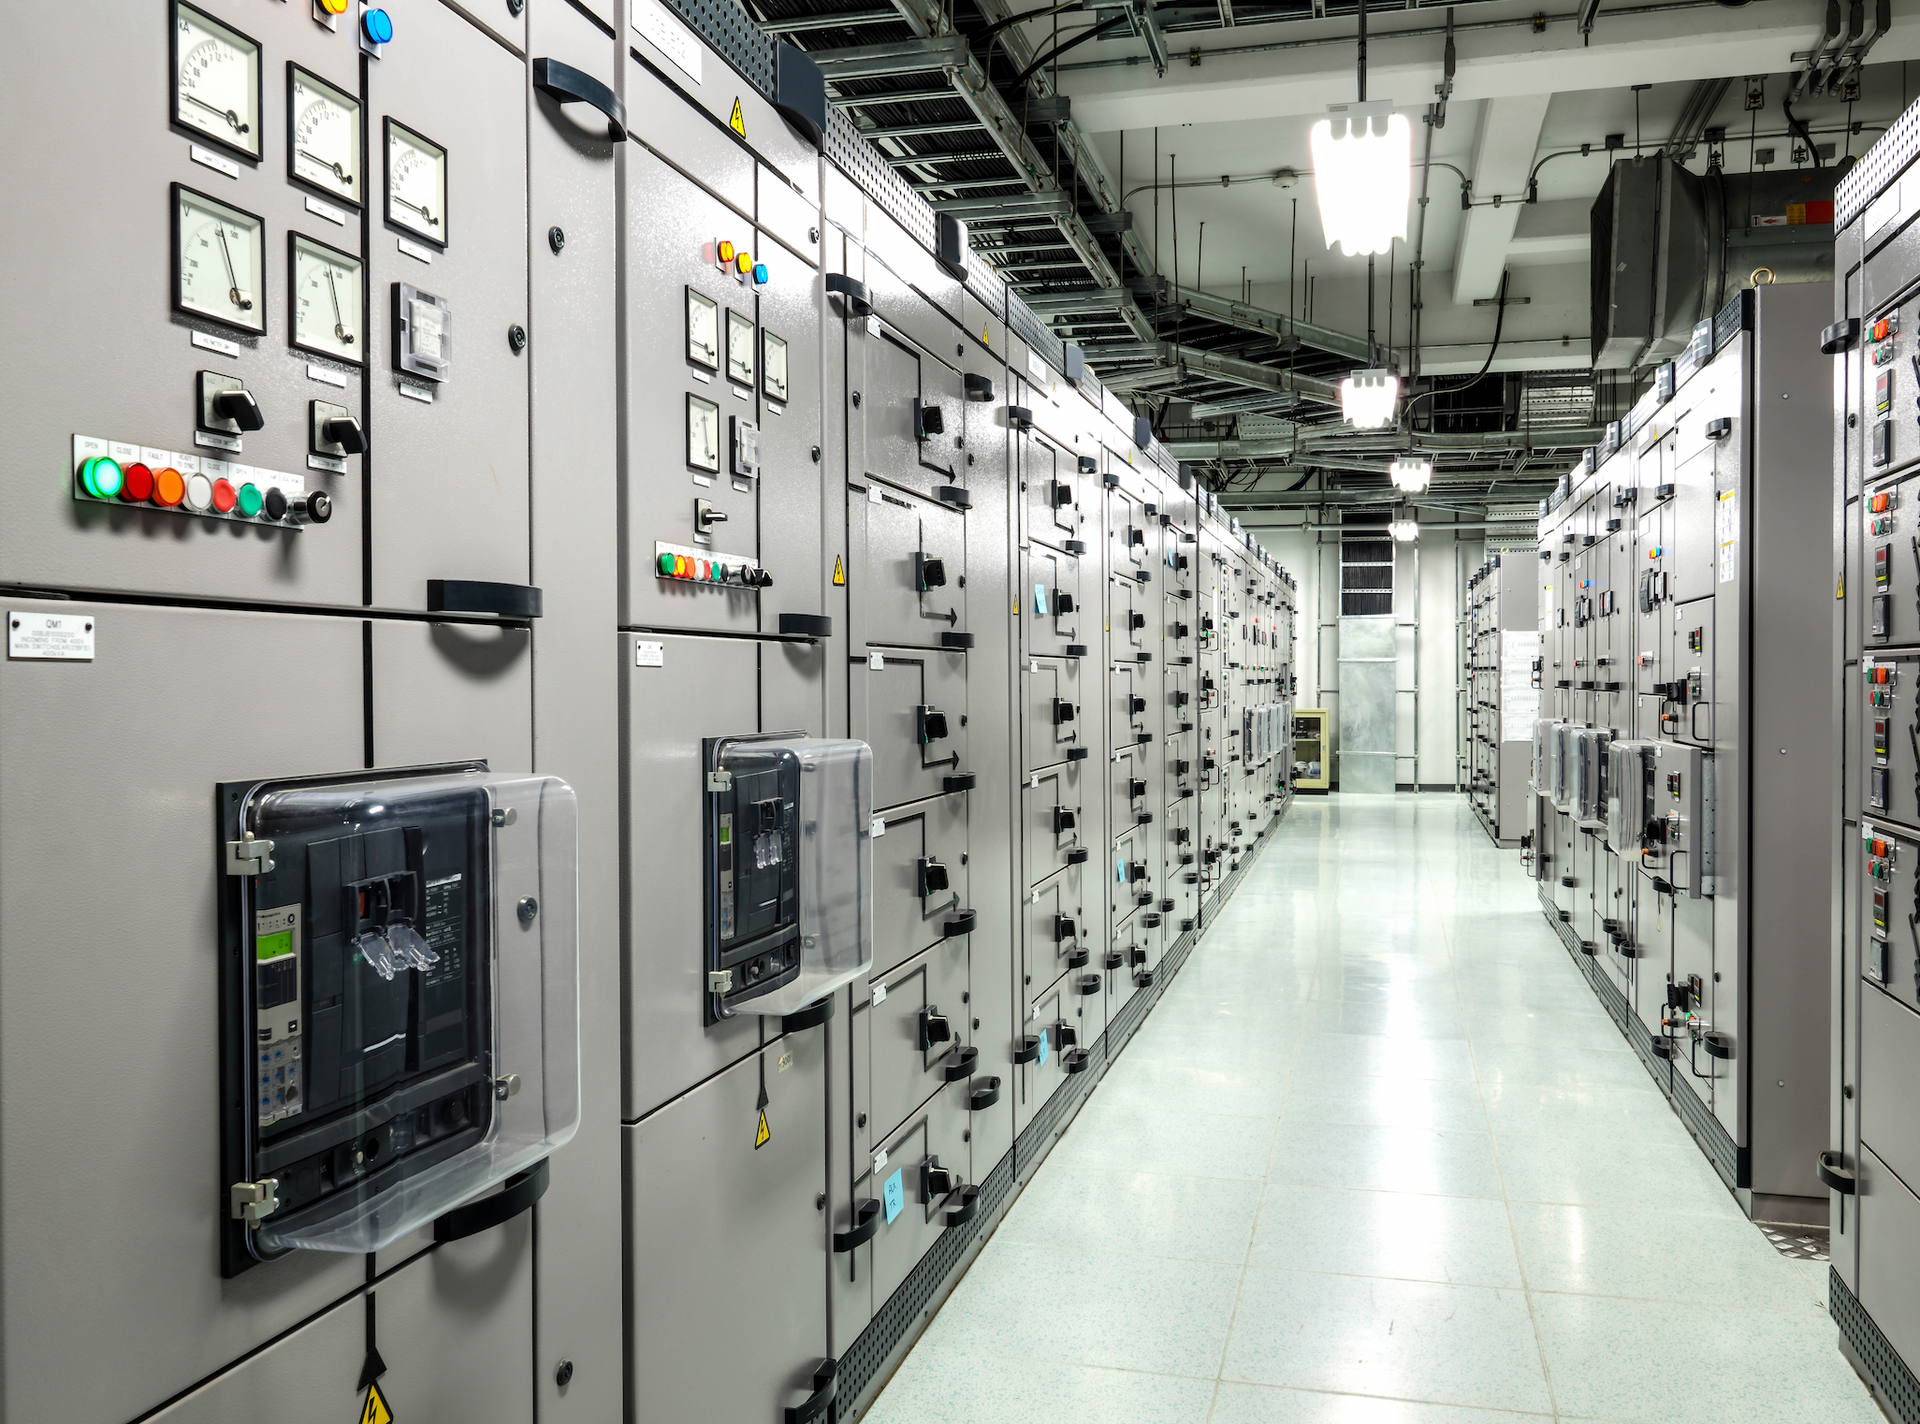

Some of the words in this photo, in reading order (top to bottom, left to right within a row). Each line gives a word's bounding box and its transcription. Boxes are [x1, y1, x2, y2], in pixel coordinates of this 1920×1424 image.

[183, 204, 190, 217] V
[230, 230, 239, 239] 500
[200, 238, 209, 248] 300
[297, 250, 304, 261] V
[84, 440, 99, 449] OPEN
[116, 446, 133, 456] CLOSE
[148, 451, 163, 460] FAULT
[207, 462, 221, 471] CLOSE
[45, 619, 62, 629] QM1
